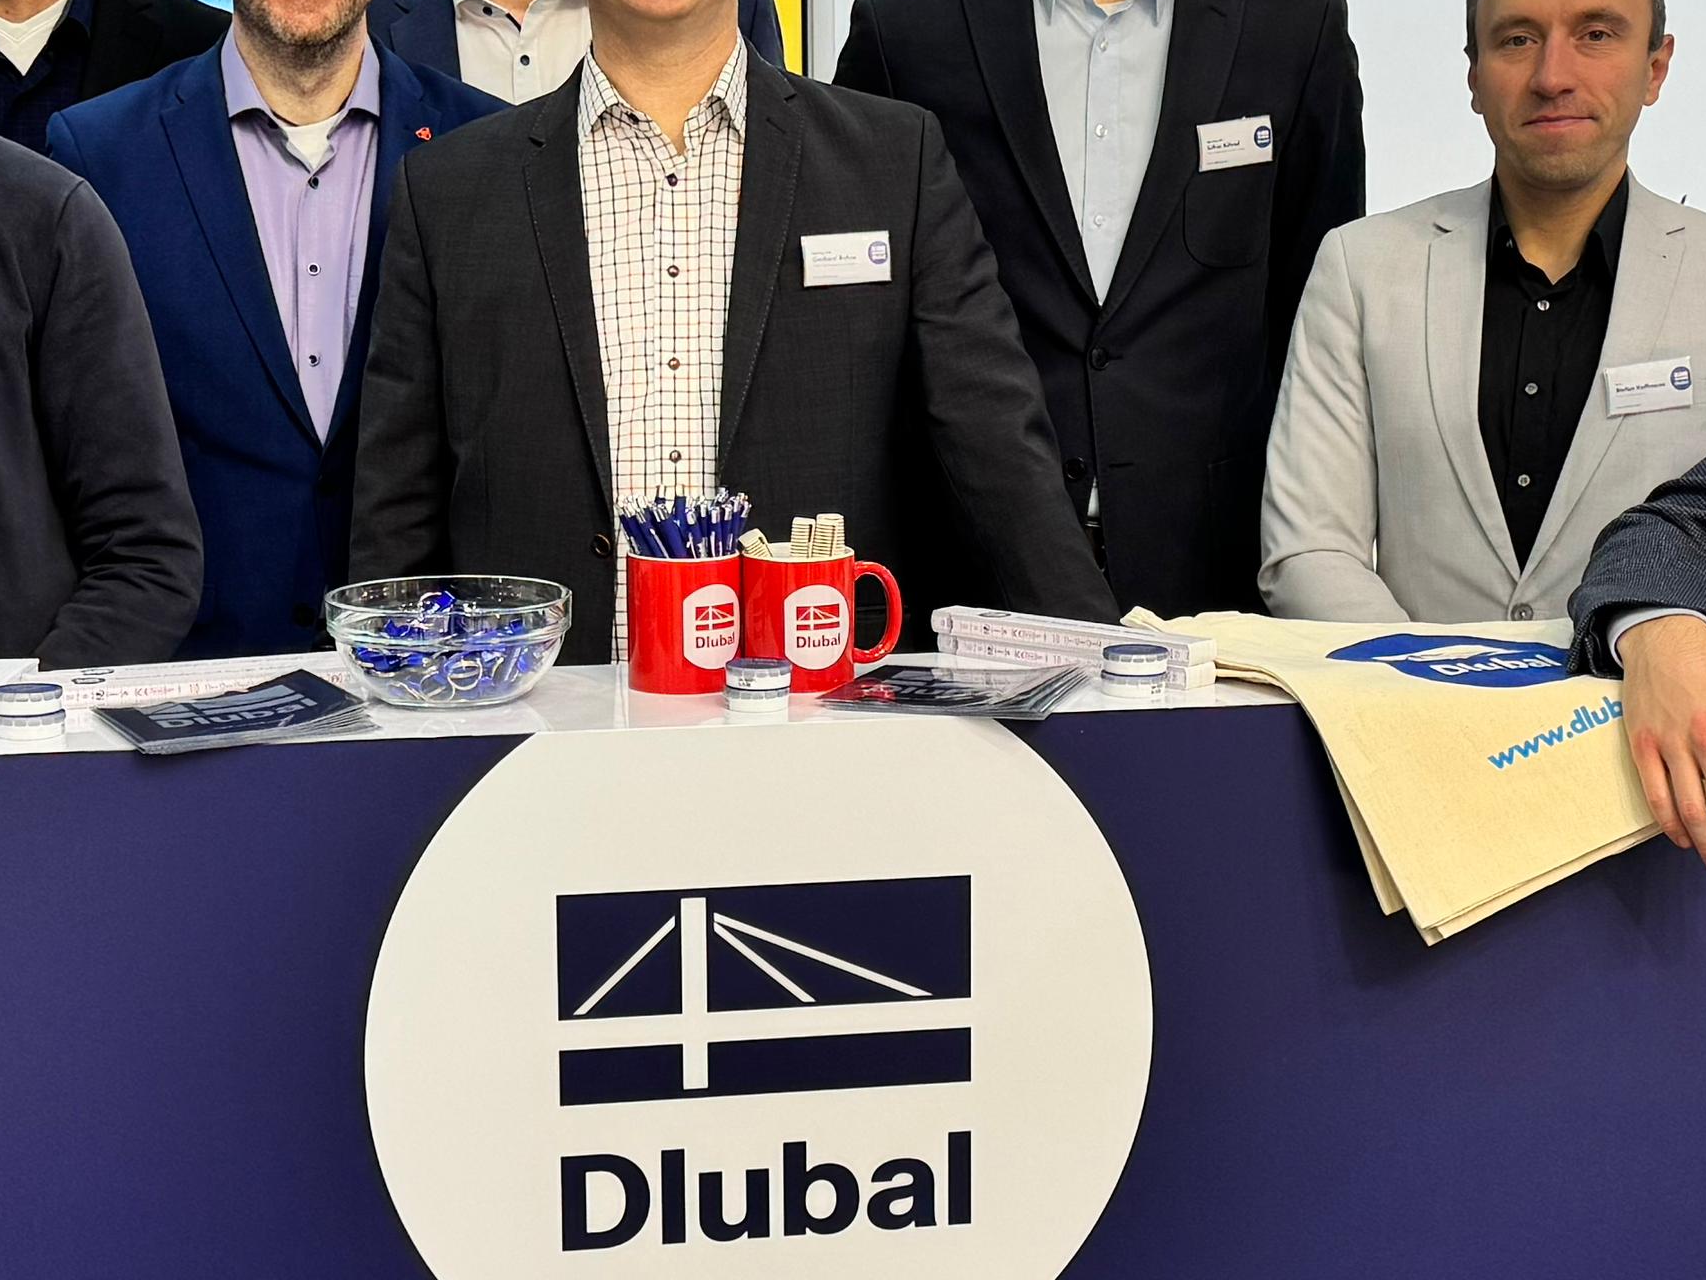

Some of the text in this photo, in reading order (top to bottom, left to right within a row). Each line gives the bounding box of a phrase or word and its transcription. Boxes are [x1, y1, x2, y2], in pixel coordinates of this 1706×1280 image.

[695, 634, 735, 650] Dlubal
[795, 633, 841, 649] Dlubal
[1429, 654, 1562, 676] Dlubal
[155, 696, 320, 730] Dlubal
[559, 1131, 973, 1251] Dlubal
